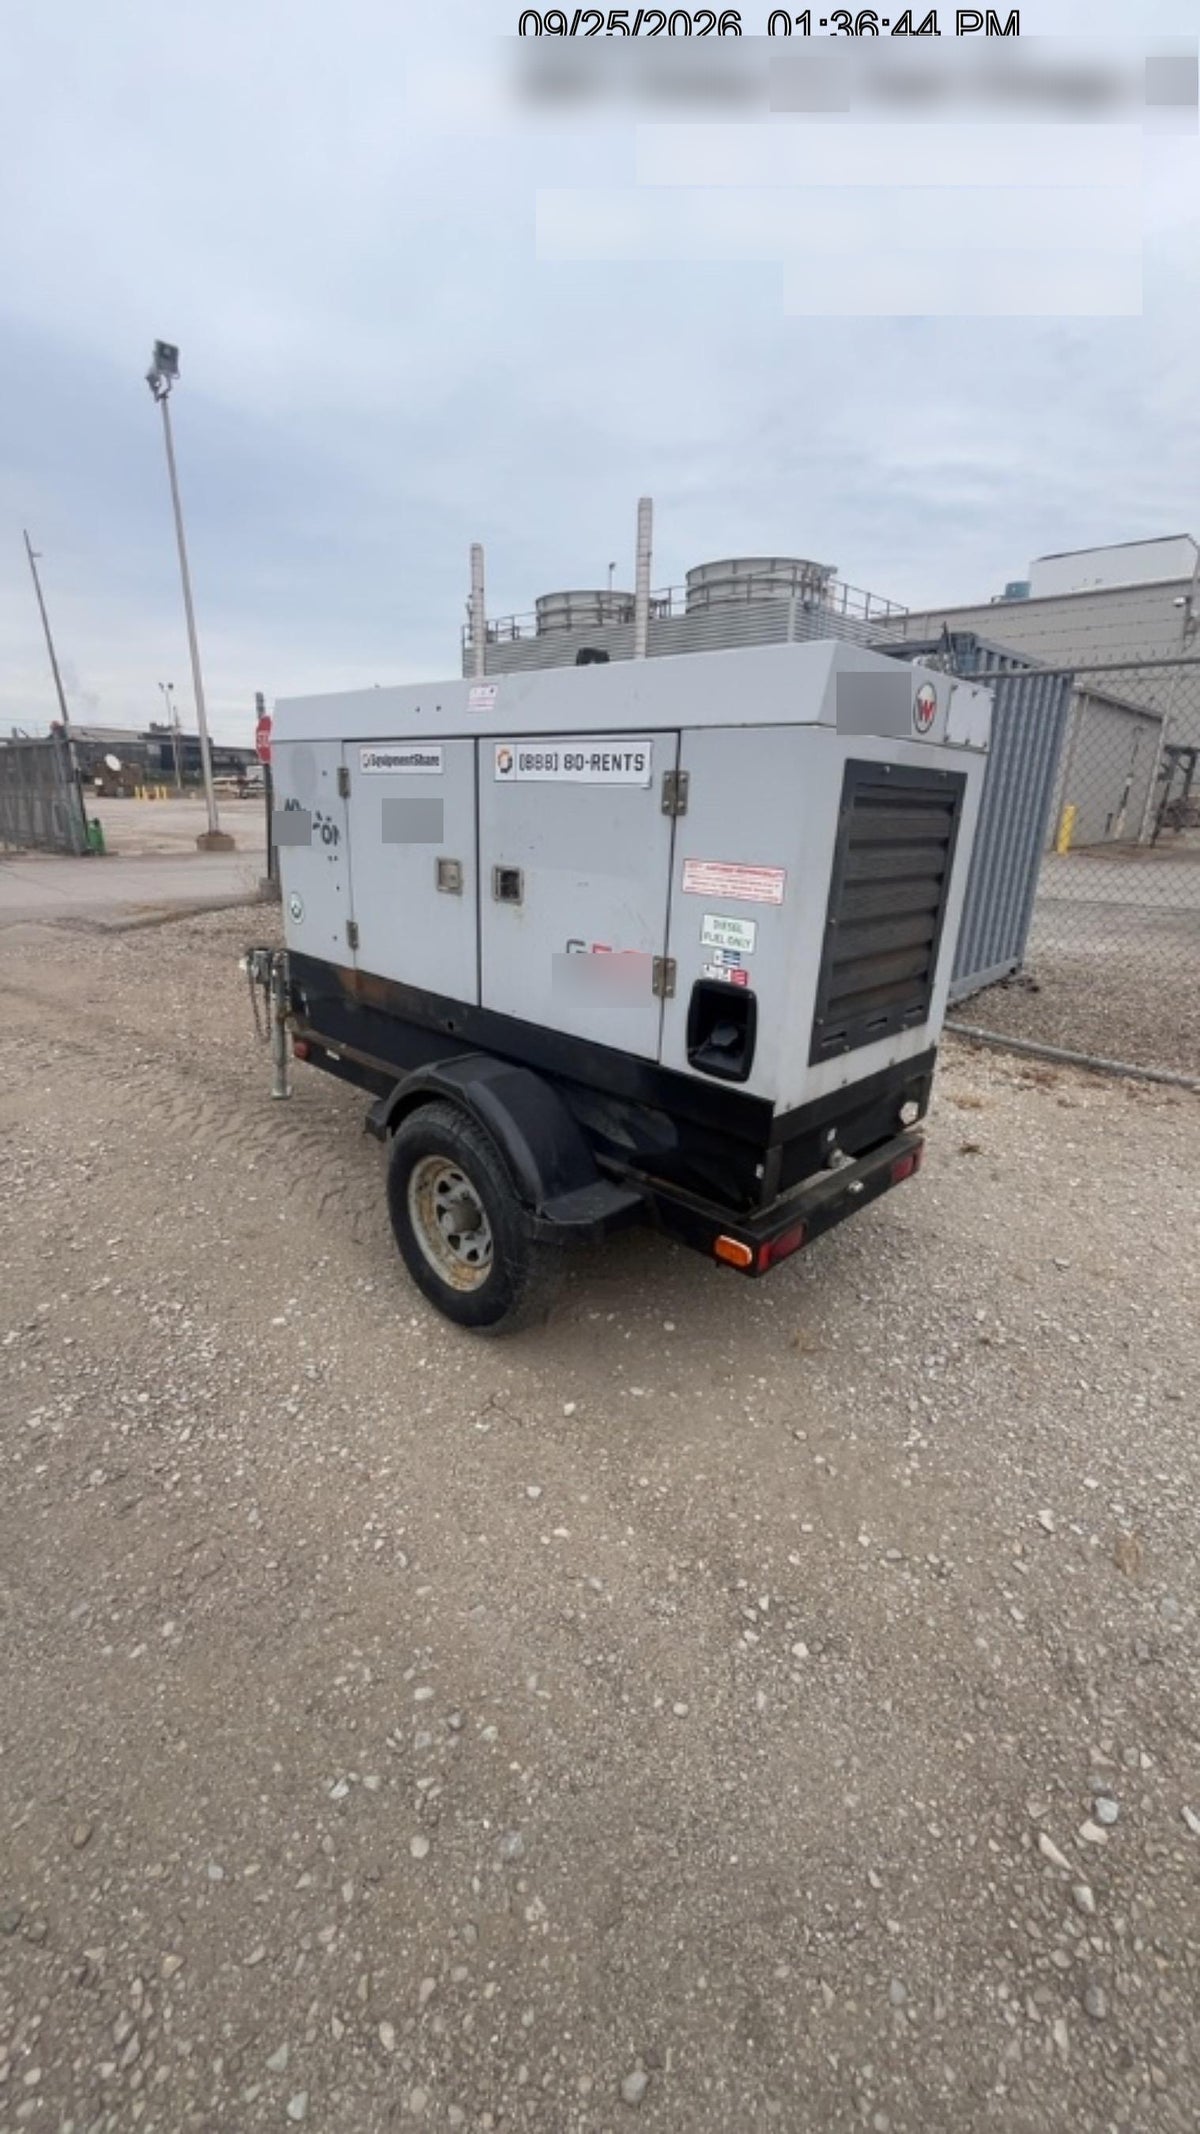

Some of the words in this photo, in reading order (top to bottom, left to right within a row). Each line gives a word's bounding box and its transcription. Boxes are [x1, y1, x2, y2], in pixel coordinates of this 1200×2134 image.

[371, 753, 439, 768] EquipmentShare
[564, 753, 645, 772] 80-RENTS
[703, 931, 725, 944] FUEL
[728, 936, 751, 948] ONLY
